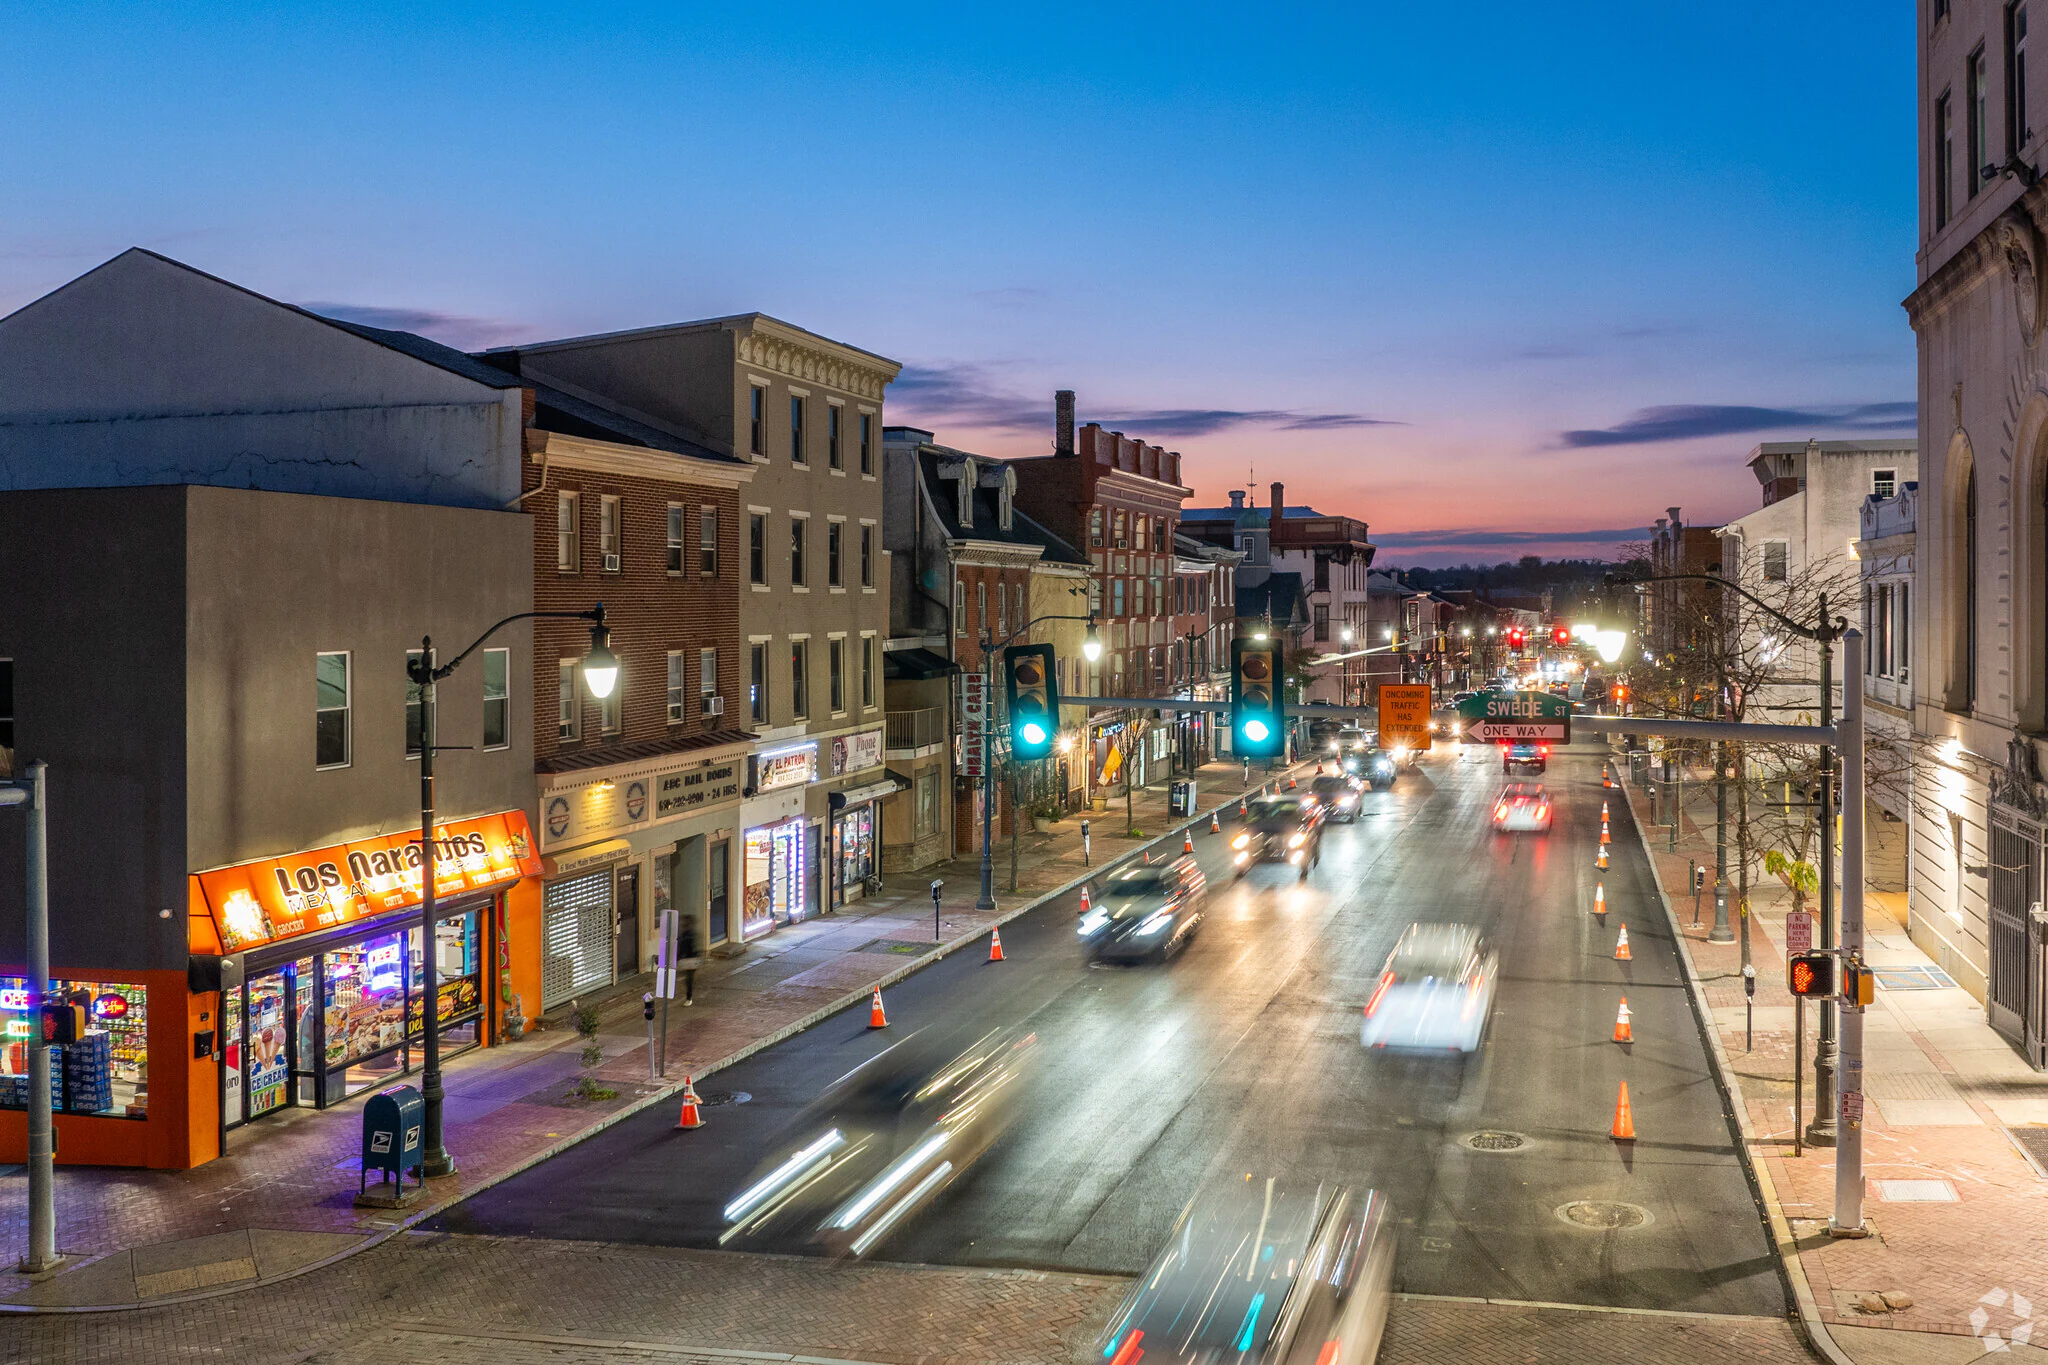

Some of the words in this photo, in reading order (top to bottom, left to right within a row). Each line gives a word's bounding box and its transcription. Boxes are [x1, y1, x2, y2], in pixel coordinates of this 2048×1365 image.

[1487, 701, 1543, 716] SWEDE
[1555, 706, 1566, 716] ST
[1386, 724, 1423, 732] EXTENDED
[1483, 726, 1510, 736] ONE
[1517, 726, 1546, 736] WAY
[856, 737, 876, 751] Phone
[775, 758, 782, 769] EL
[663, 778, 680, 791] ABC
[684, 774, 704, 786] BAIL
[706, 767, 732, 782] BONDS
[723, 784, 737, 796] HRS
[590, 855, 603, 863] Street
[288, 881, 376, 914] MEXCAN
[1794, 914, 1803, 922] NO
[277, 919, 305, 936] GROCERY
[2, 990, 30, 1009] OPE
[103, 1001, 124, 1013] Coffee
[408, 1017, 425, 1034] Del
[251, 1079, 262, 1091] CE
[263, 1067, 289, 1086] CREAM
